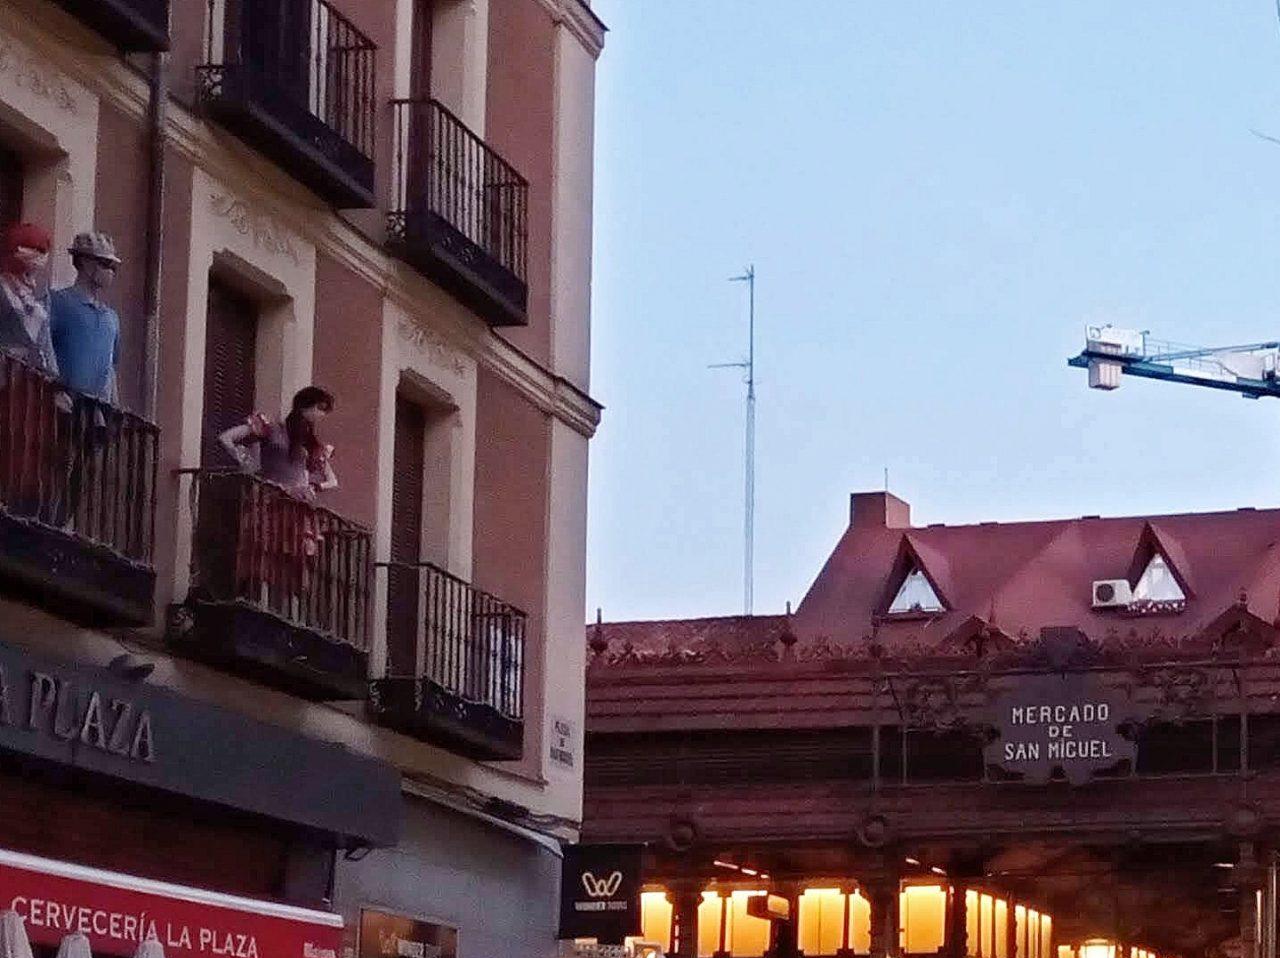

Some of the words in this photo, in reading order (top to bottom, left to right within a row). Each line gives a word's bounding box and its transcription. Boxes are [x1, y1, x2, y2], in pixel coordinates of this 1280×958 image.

[30, 671, 155, 762] PLAZA
[1012, 704, 1109, 724] MERCADO
[1049, 725, 1073, 738] DE
[1005, 743, 1039, 760] SAN
[11, 896, 158, 943] CERVECERÍA
[167, 923, 192, 950] LA
